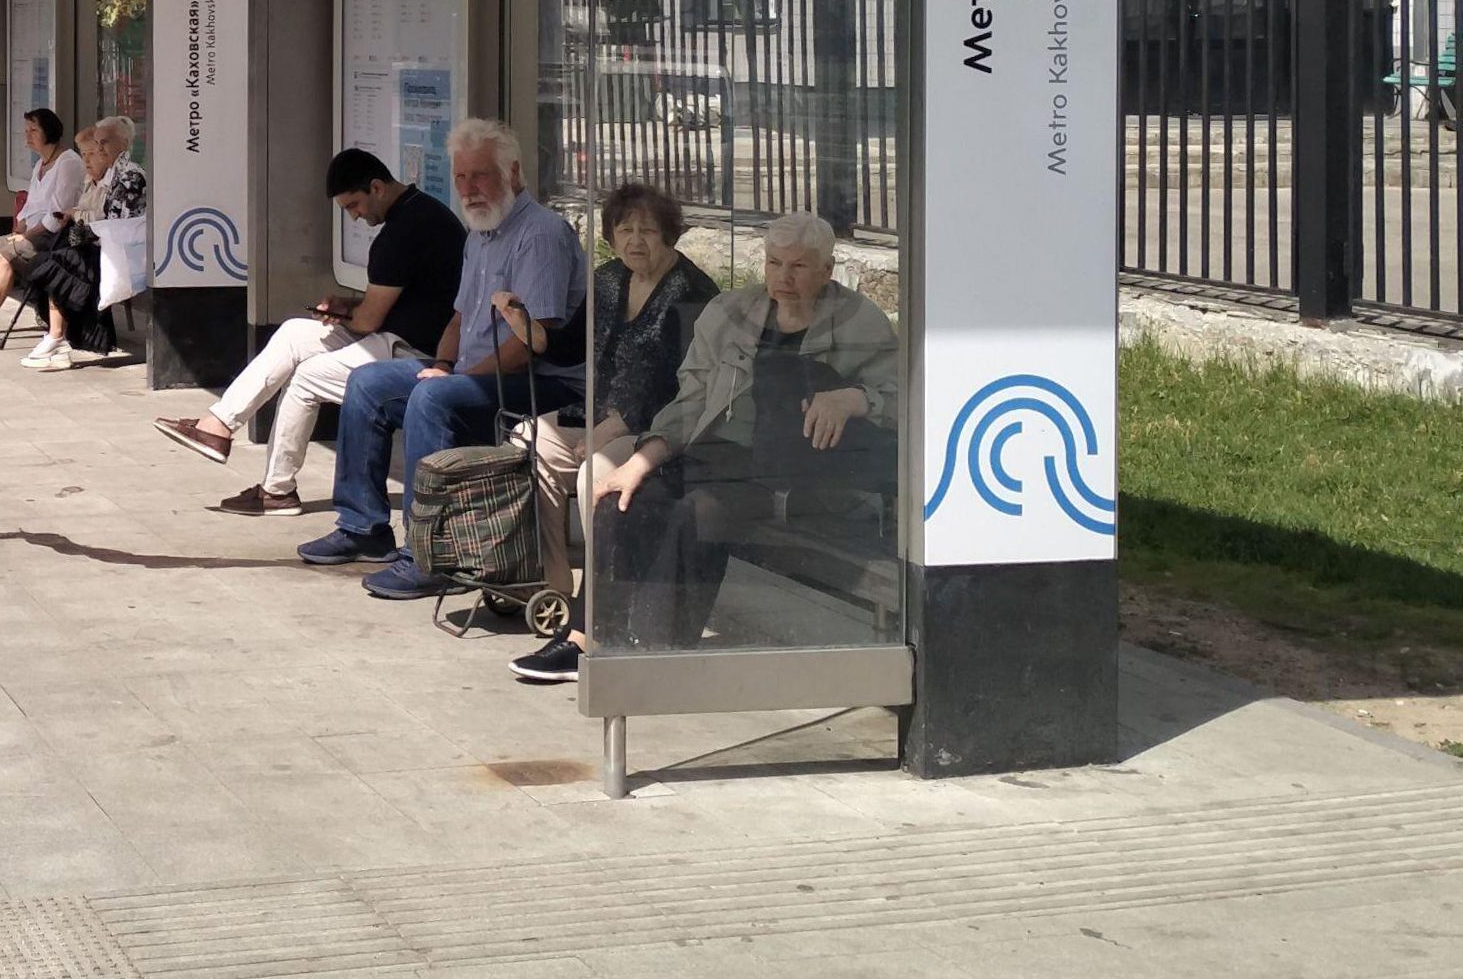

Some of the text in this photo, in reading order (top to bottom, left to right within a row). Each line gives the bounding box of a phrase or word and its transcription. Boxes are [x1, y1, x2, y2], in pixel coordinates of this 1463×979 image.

[185, 0, 200, 98] «Каховская»
[205, 52, 217, 85] Metro
[185, 101, 202, 154] Метро
[1046, 94, 1069, 177] Metro
